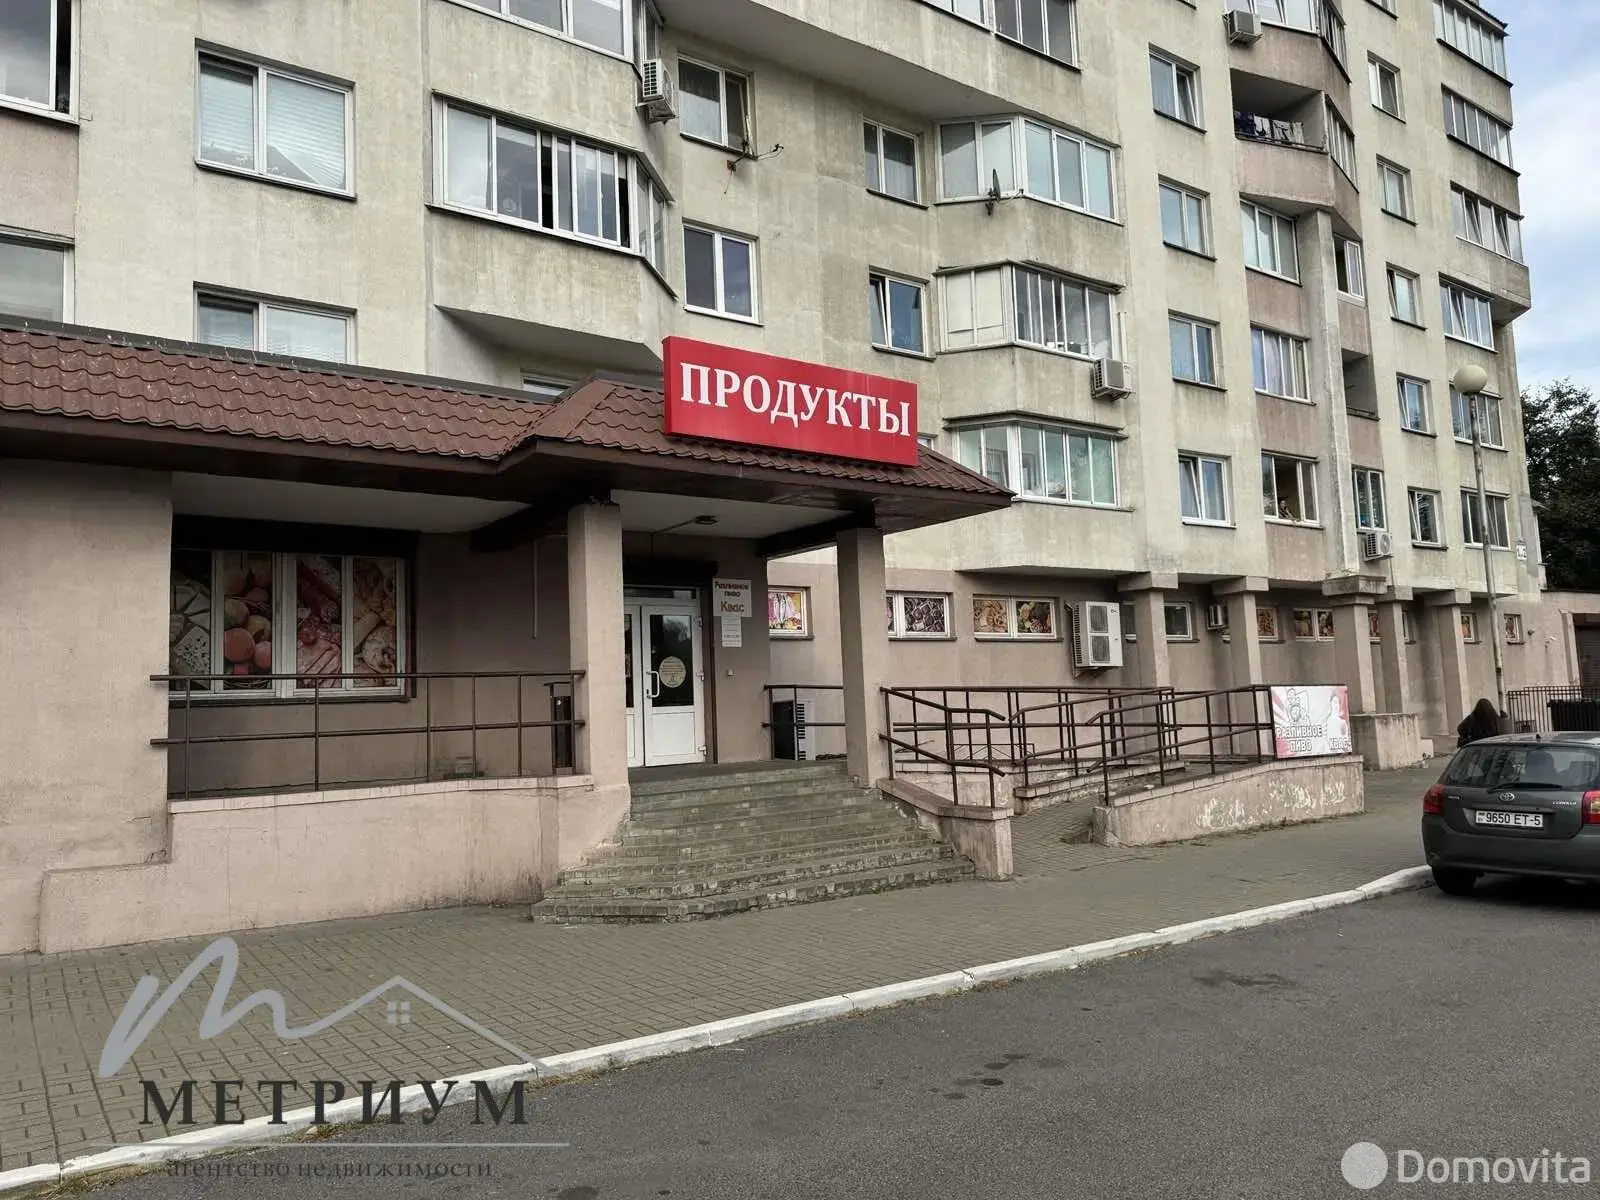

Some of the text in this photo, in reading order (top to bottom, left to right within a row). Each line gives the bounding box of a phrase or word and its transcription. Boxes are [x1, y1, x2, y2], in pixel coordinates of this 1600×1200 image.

[679, 361, 911, 437] ПРОДУКТЫ
[720, 600, 745, 613] Квас
[1275, 725, 1323, 739] РАЗЛИВНОЕ
[1290, 739, 1313, 752] ПИВО
[1486, 812, 1511, 824] 9650
[1514, 814, 1541, 826] ET-5
